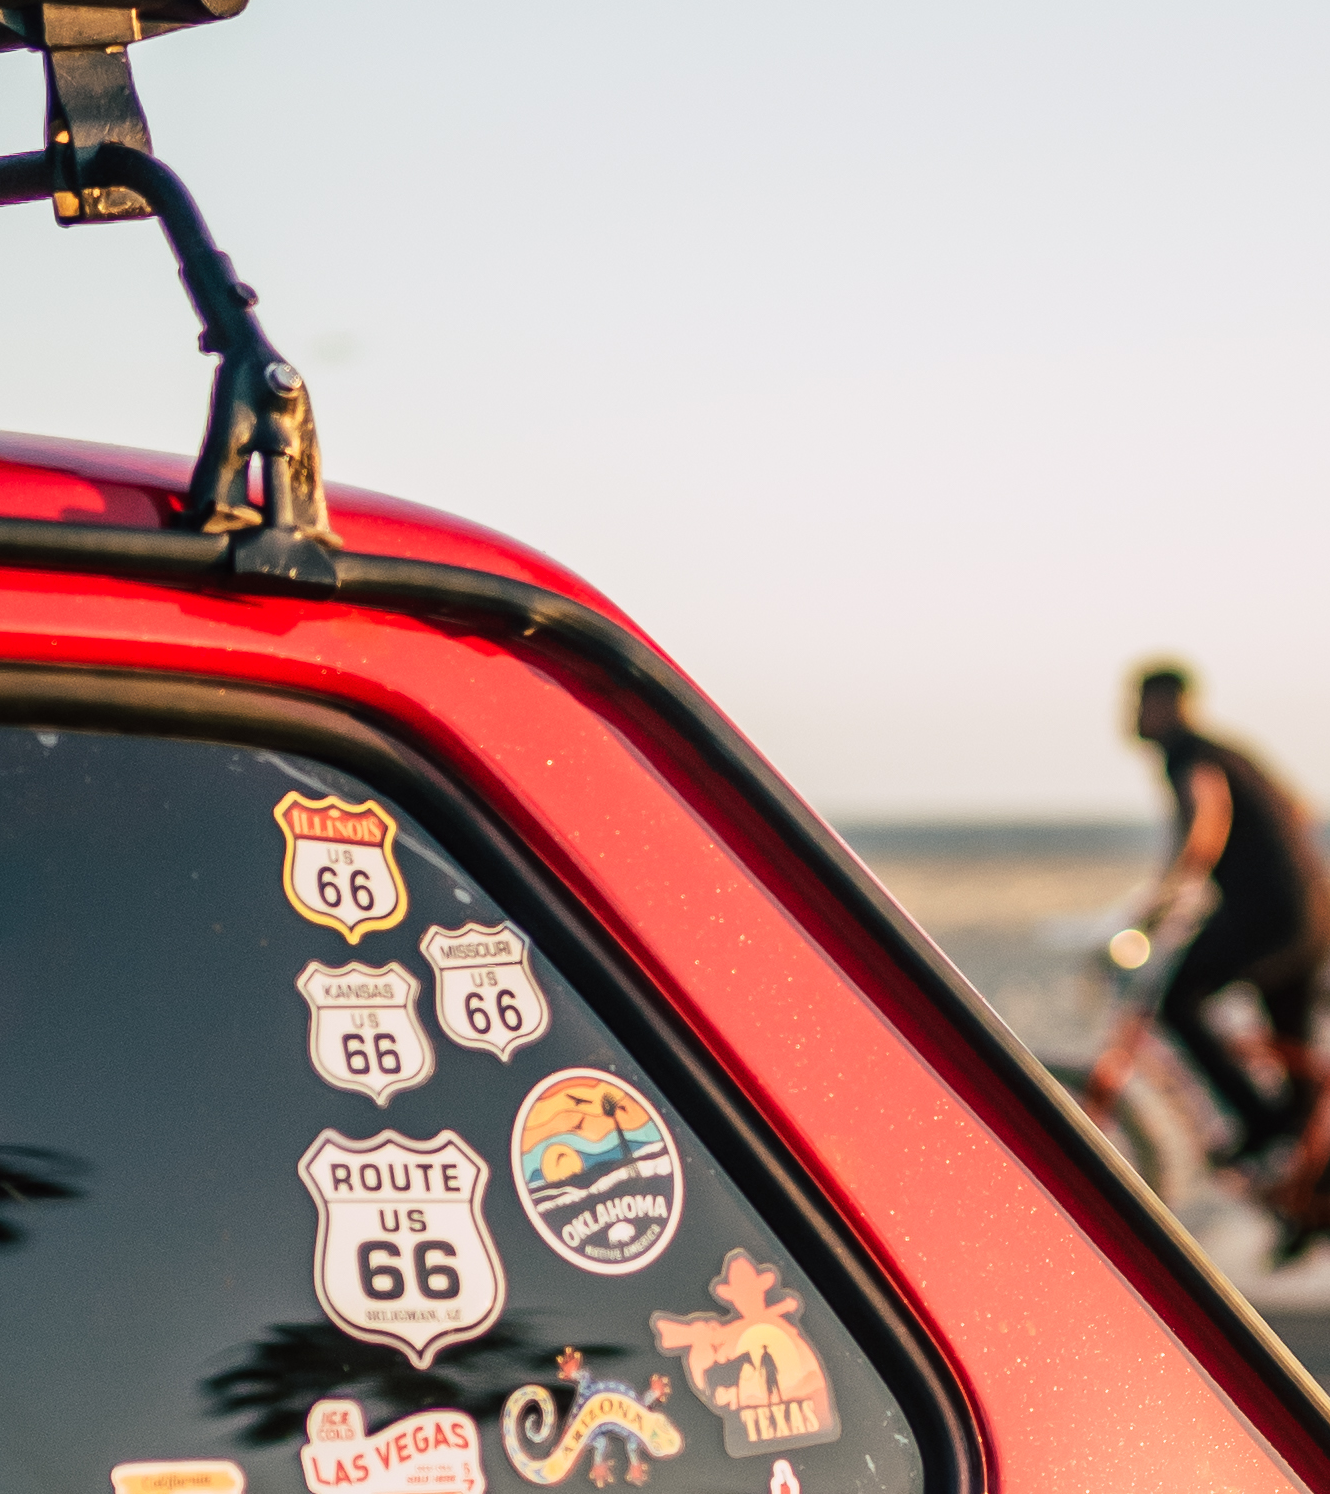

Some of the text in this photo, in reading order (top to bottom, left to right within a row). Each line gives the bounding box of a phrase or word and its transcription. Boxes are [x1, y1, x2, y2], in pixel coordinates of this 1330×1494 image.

[326, 847, 354, 866] US
[317, 866, 375, 912] 66
[440, 940, 512, 959] MISSOURI
[322, 983, 394, 1000] KANSAS
[470, 970, 498, 988] US
[349, 1012, 379, 1029] US
[464, 989, 523, 1035] 66
[342, 1033, 402, 1075] 66
[329, 1162, 462, 1193] ROUTE
[379, 1208, 428, 1233] US
[561, 1194, 668, 1248] OKLAHOMA
[357, 1239, 462, 1301] 66
[562, 1397, 644, 1460] ARIZONA
[740, 1399, 820, 1443] TEXAS
[312, 1422, 470, 1487] LAS VEGAS
